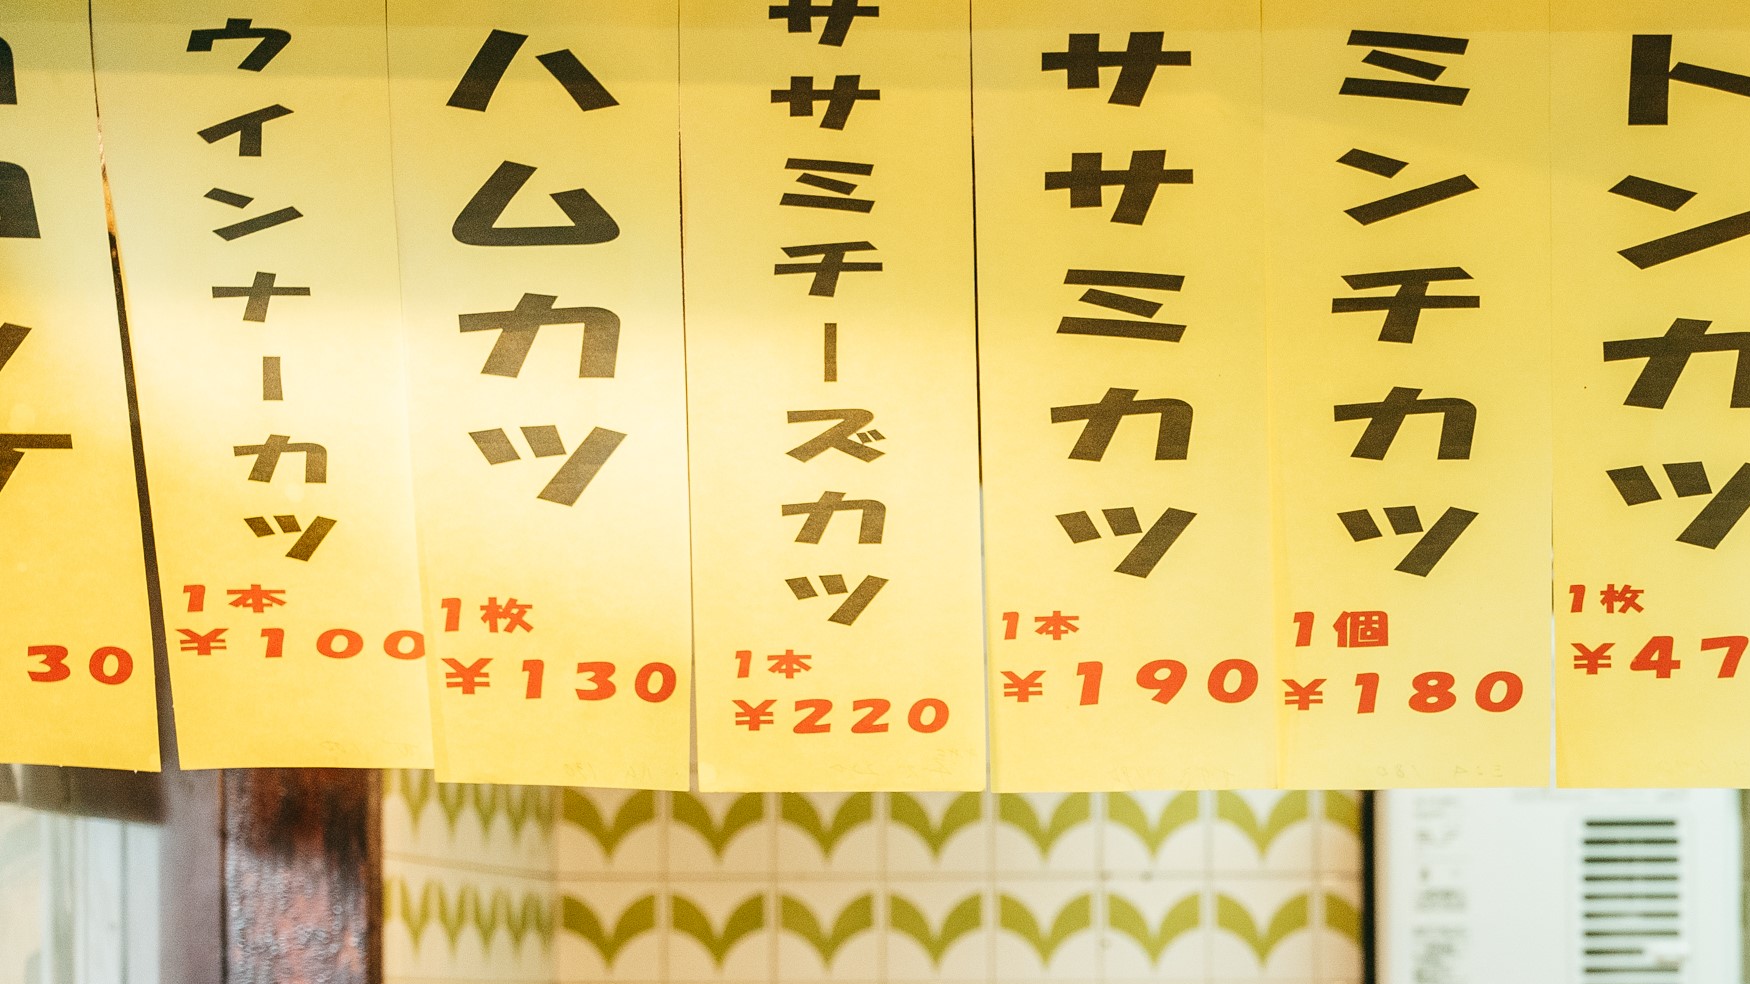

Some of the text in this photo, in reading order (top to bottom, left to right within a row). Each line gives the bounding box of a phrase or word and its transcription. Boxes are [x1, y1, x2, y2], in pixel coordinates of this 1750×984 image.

[186, 18, 310, 559] ウインナーカツ
[446, 29, 627, 507] ハムカツ
[768, 0, 890, 627] ササミチーズカツ
[1042, 32, 1197, 578] ササミカツ
[1332, 30, 1480, 577] ミンチカツ
[177, 628, 423, 659] ¥100
[442, 659, 676, 702] ¥130
[734, 699, 948, 733] ¥220
[1002, 659, 1258, 705] ¥190
[1283, 672, 1523, 713] ¥180
